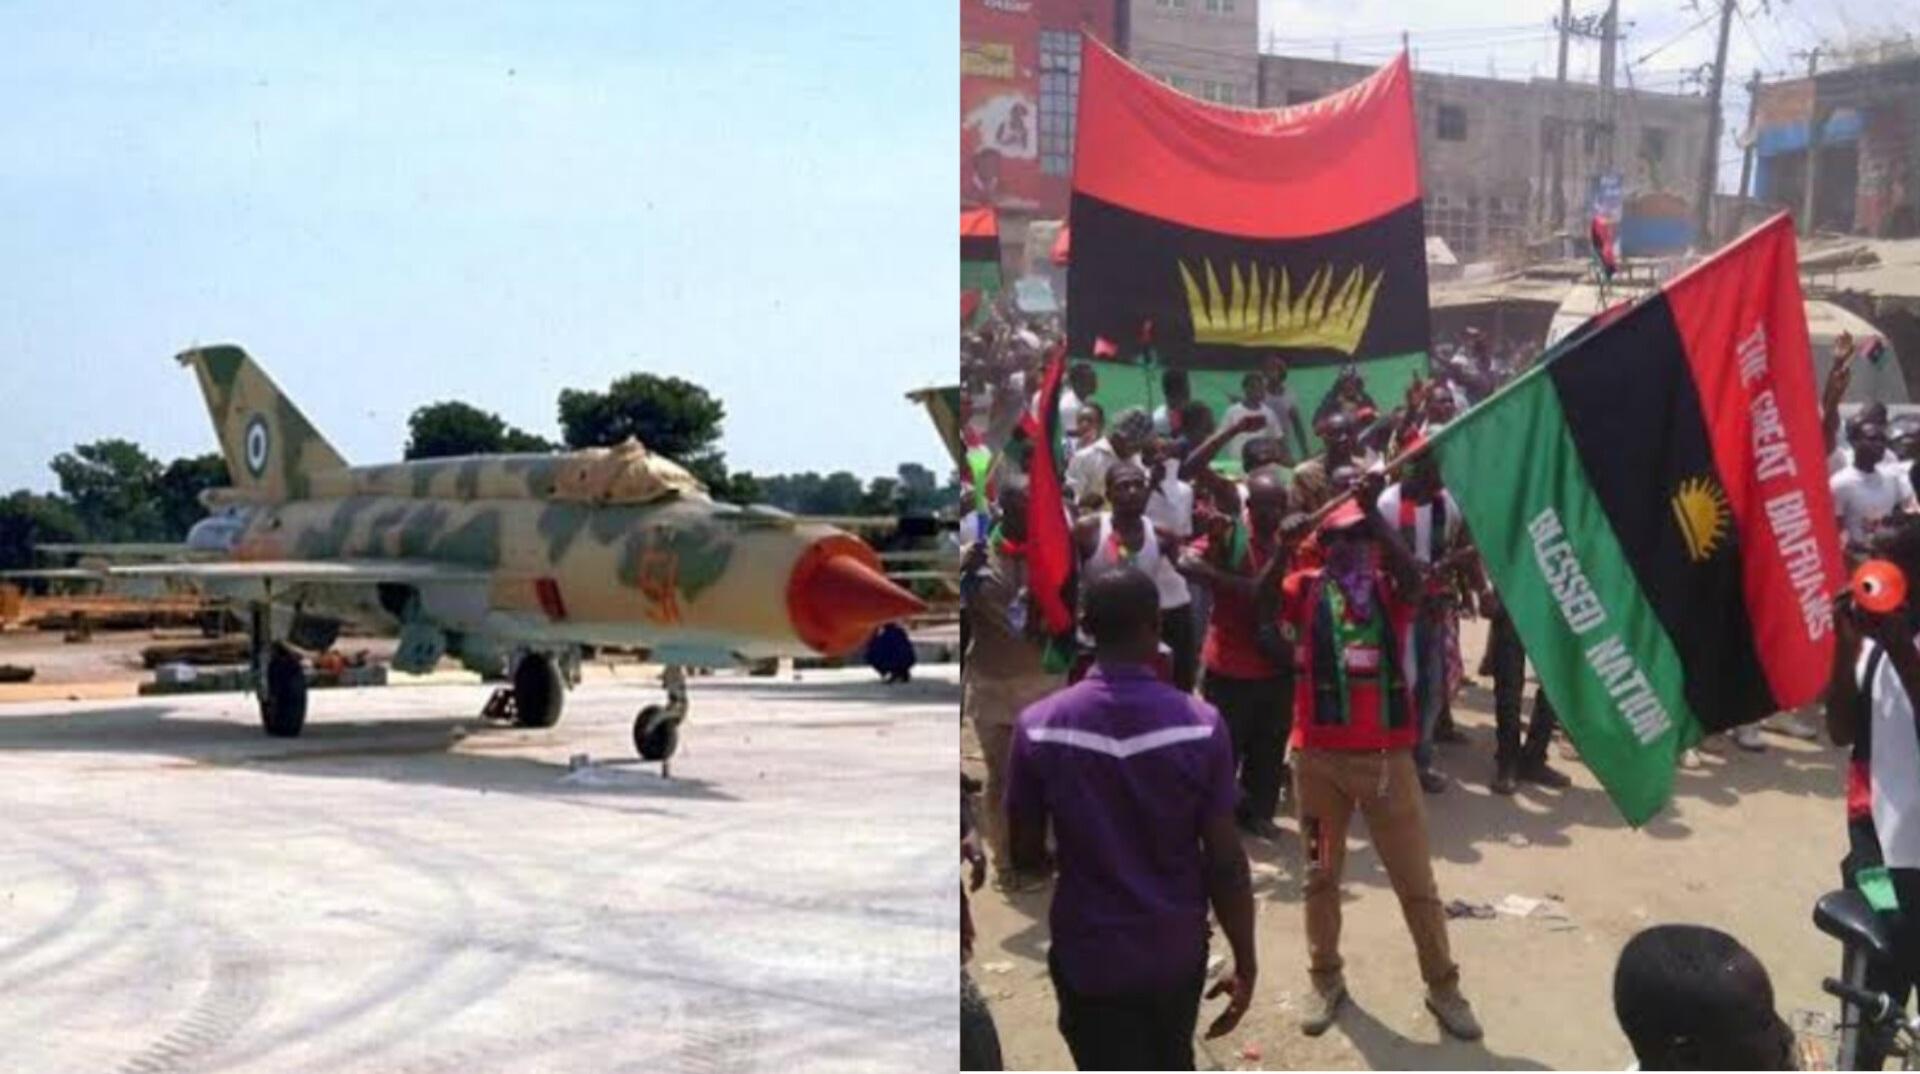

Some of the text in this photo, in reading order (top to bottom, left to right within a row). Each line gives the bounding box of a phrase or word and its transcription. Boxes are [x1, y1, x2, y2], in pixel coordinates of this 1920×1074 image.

[1737, 323, 1834, 641] THE GREAT BIAFRANS
[1528, 509, 1671, 744] BLESSED NATION
